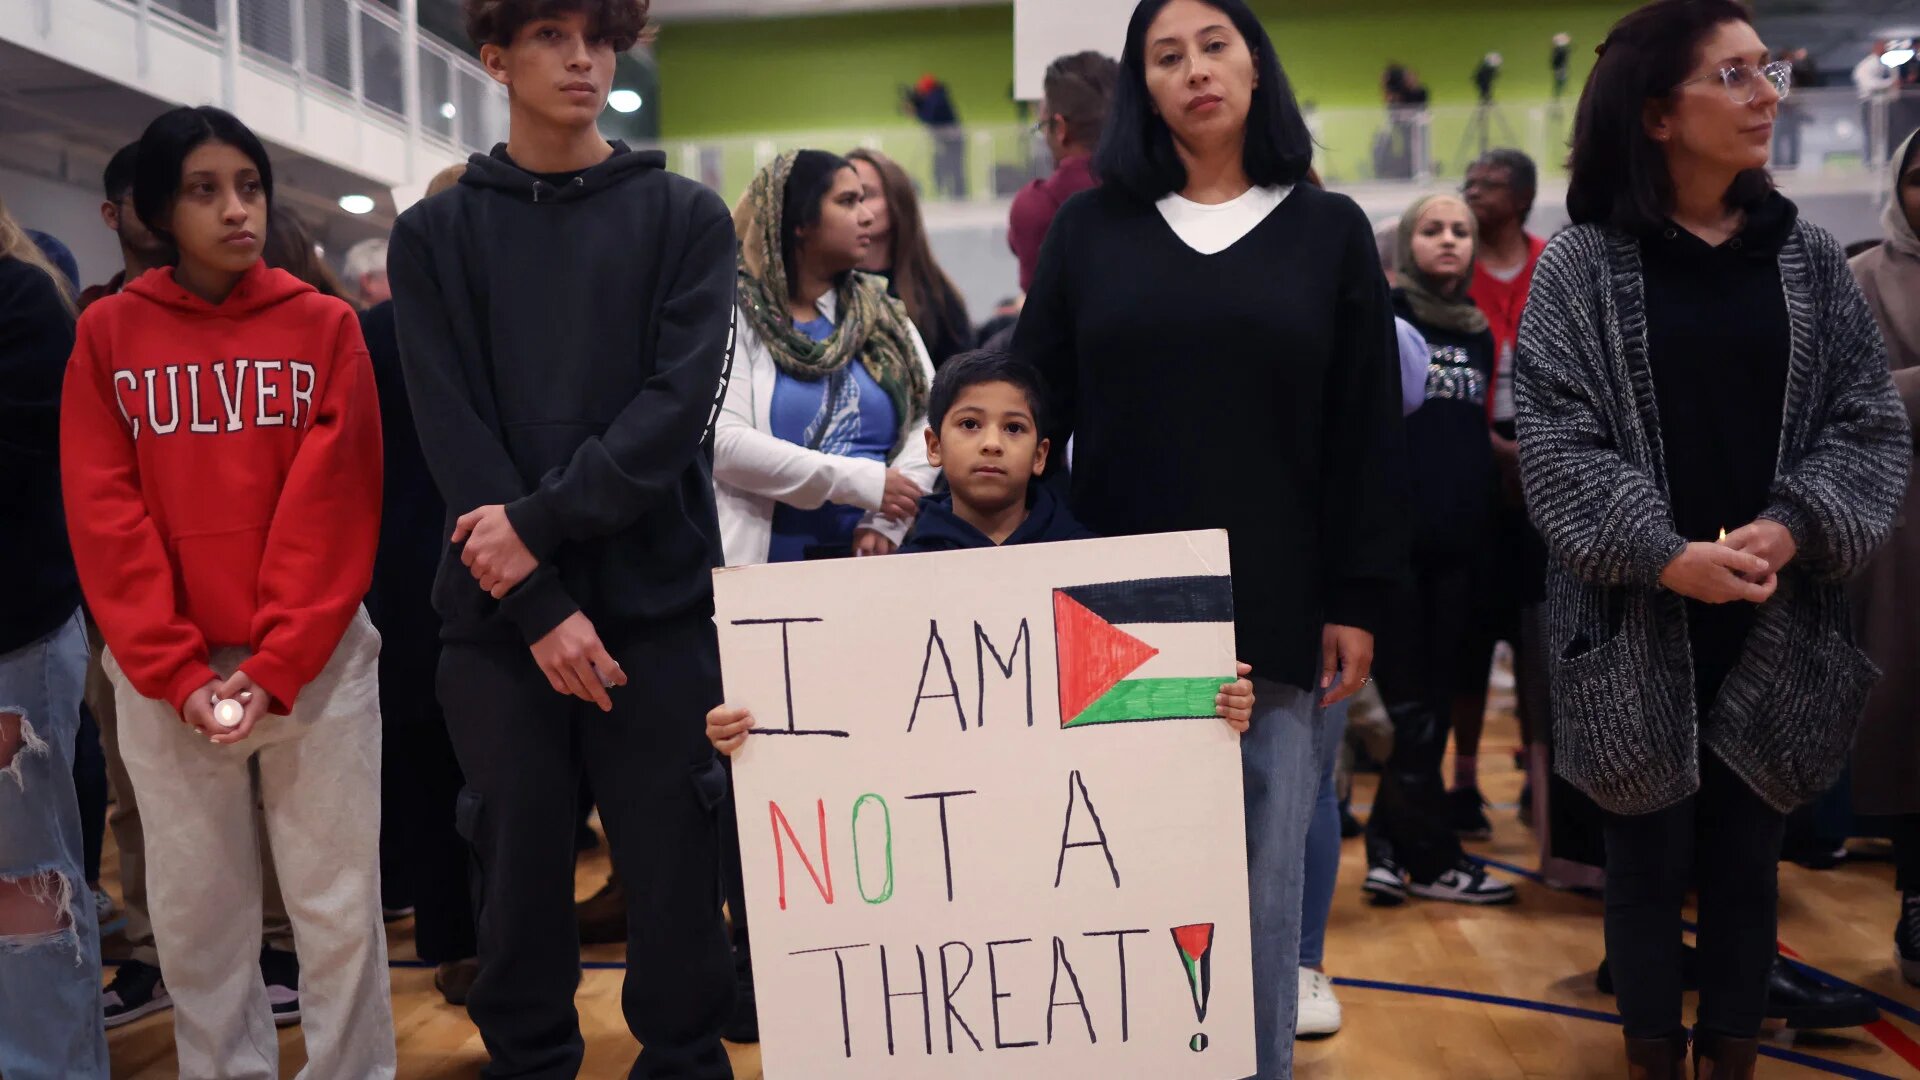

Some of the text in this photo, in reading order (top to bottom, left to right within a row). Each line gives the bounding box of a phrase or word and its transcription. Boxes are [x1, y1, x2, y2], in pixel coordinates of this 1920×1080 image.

[114, 359, 316, 439] CULVER
[731, 617, 1033, 737] I AM
[770, 769, 1120, 910] NOT A
